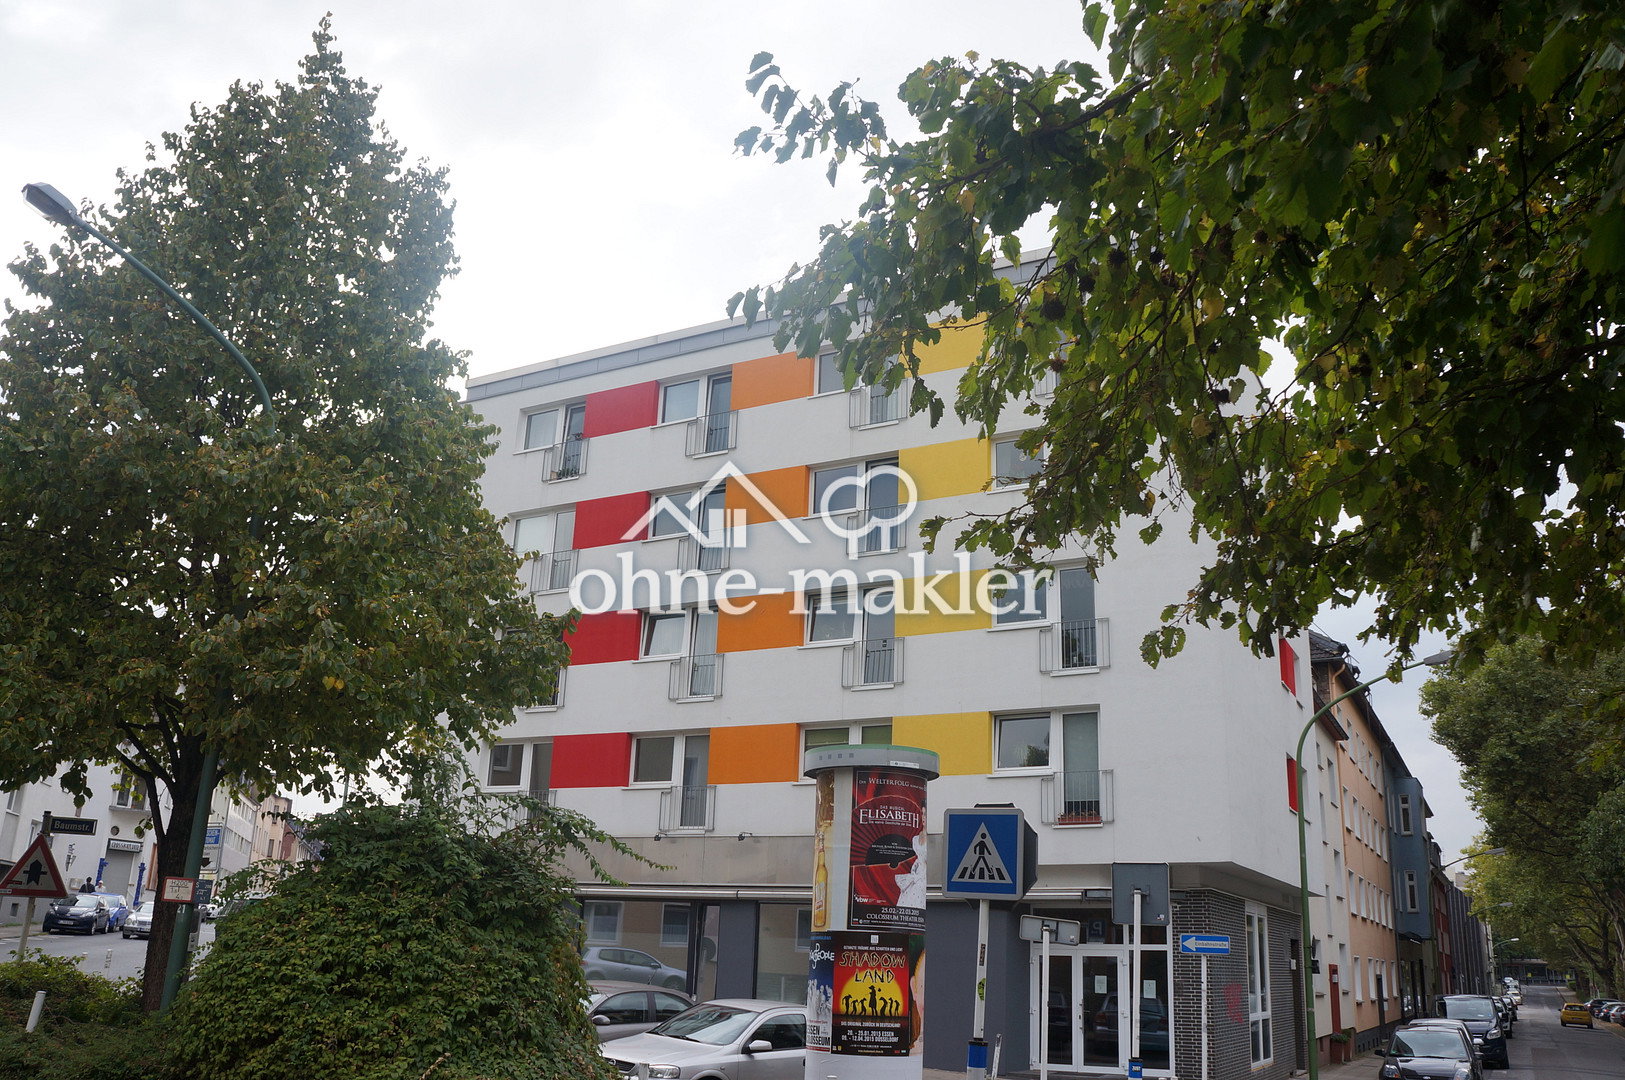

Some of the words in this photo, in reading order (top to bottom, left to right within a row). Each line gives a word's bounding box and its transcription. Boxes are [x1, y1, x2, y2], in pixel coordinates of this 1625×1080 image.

[868, 777, 910, 787] WELTERFOLG
[859, 808, 919, 828] ELISABETH
[54, 821, 90, 832] Baumstr.
[839, 951, 906, 968] SHADOW
[854, 968, 895, 983] LAND
